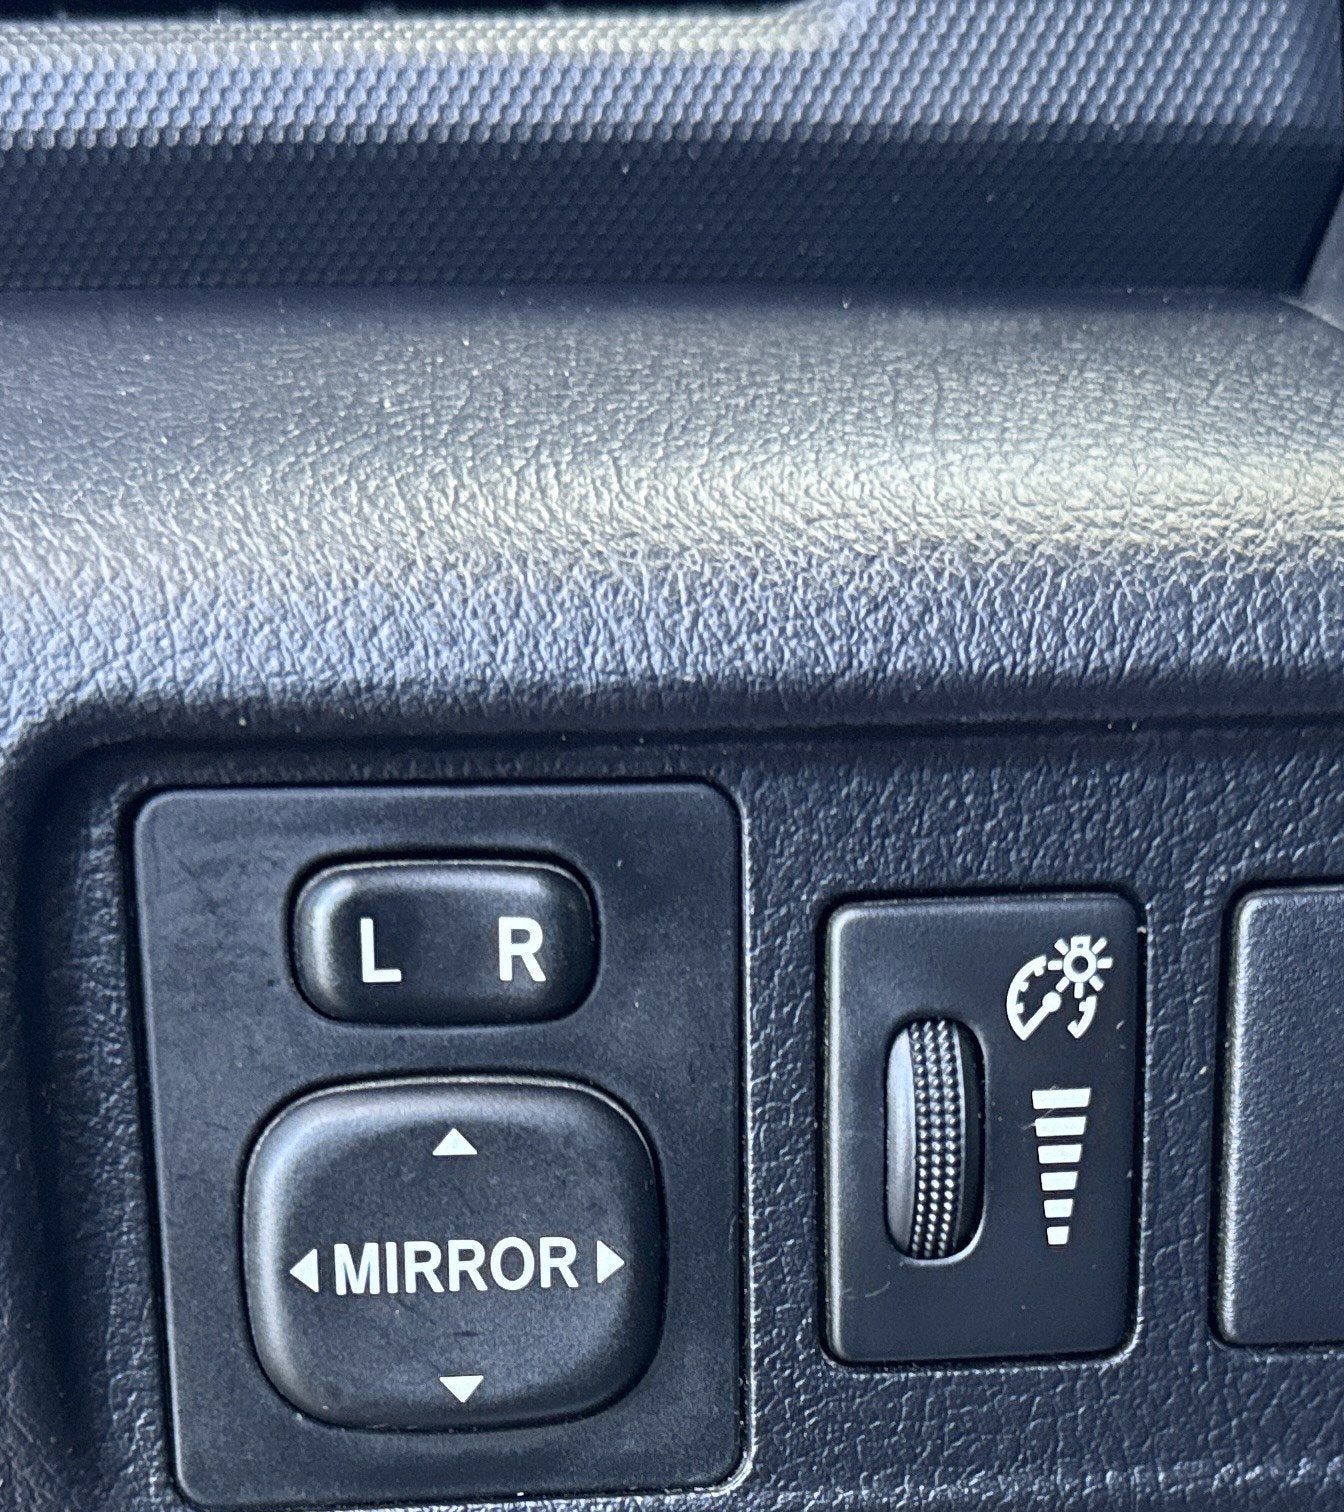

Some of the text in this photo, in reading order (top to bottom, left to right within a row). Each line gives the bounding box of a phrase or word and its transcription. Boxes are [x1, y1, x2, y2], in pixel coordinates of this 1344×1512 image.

[360, 916, 546, 983] L R
[333, 1236, 579, 1296] MIRROR
